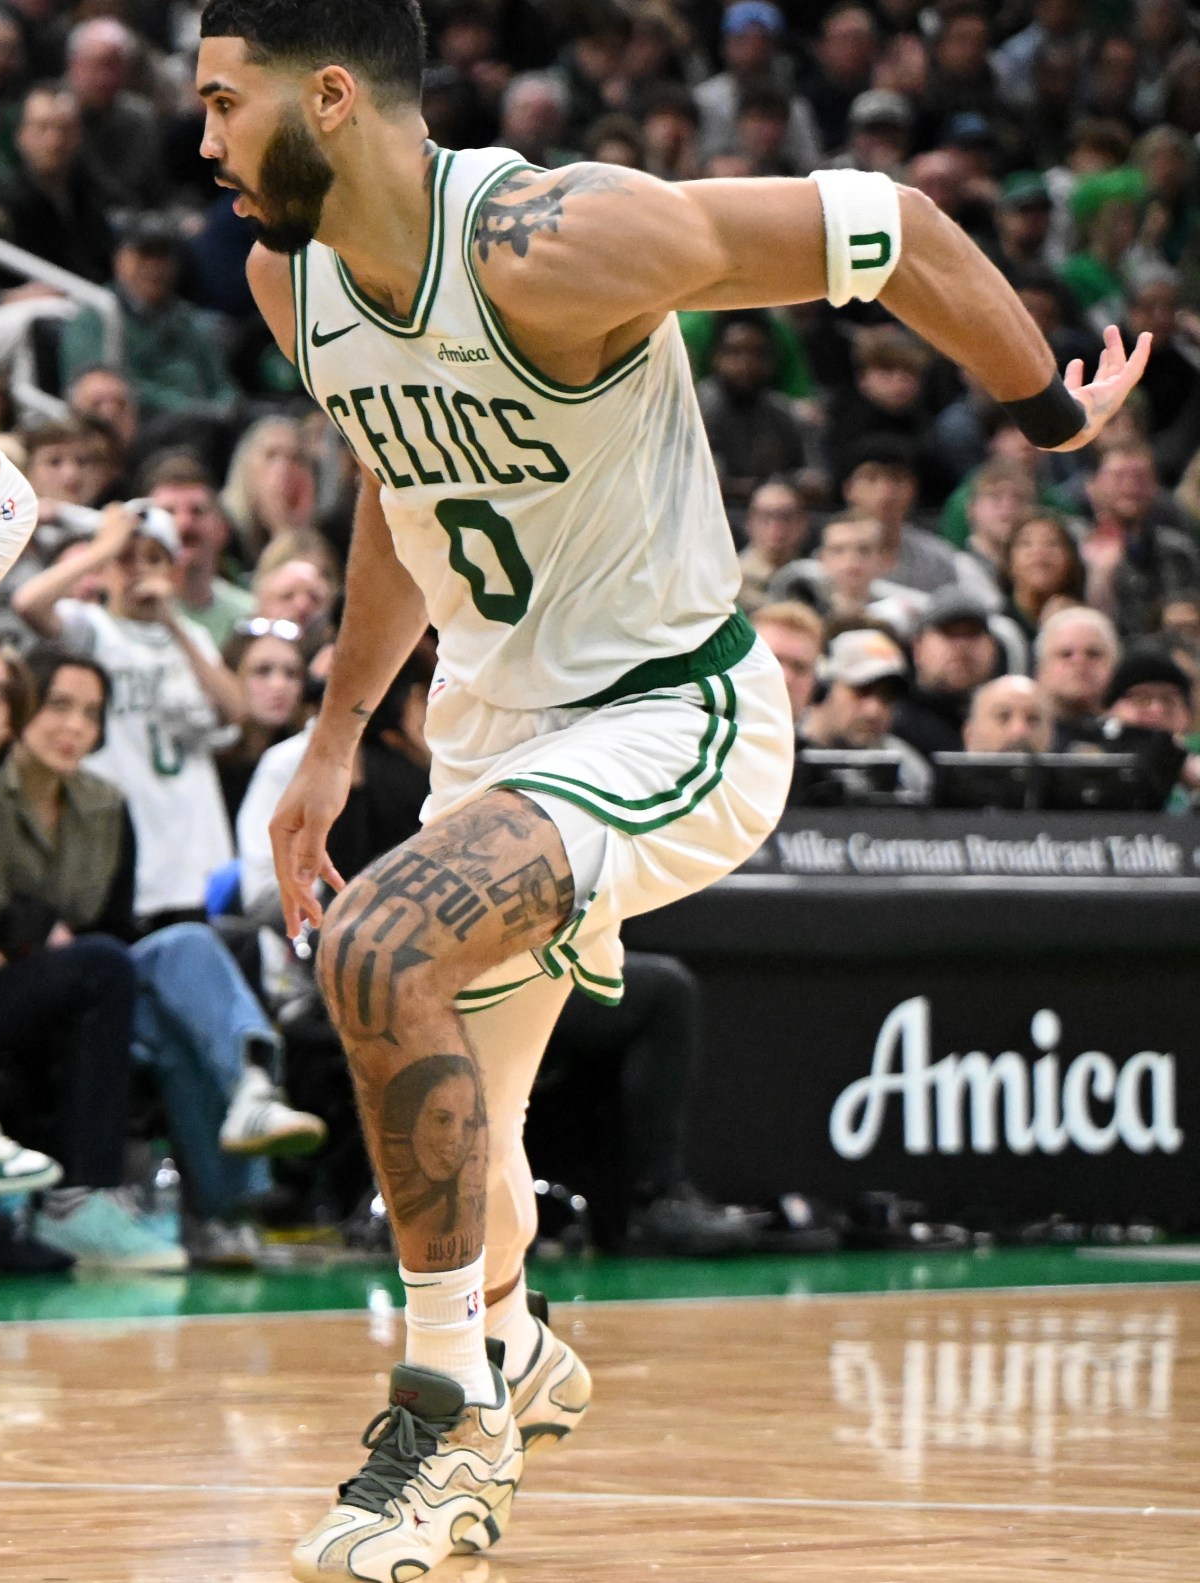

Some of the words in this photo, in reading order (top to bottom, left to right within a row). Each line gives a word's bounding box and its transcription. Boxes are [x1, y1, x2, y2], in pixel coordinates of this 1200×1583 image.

[437, 342, 490, 362] Amica
[326, 384, 570, 489] CELTICS
[435, 498, 534, 627] 0
[375, 850, 489, 943] TEFUL
[777, 830, 846, 873] Mike
[847, 832, 964, 873] Gorman
[965, 833, 1105, 874] Broadcast
[1105, 833, 1182, 875] Table
[829, 995, 1184, 1161] Amica
